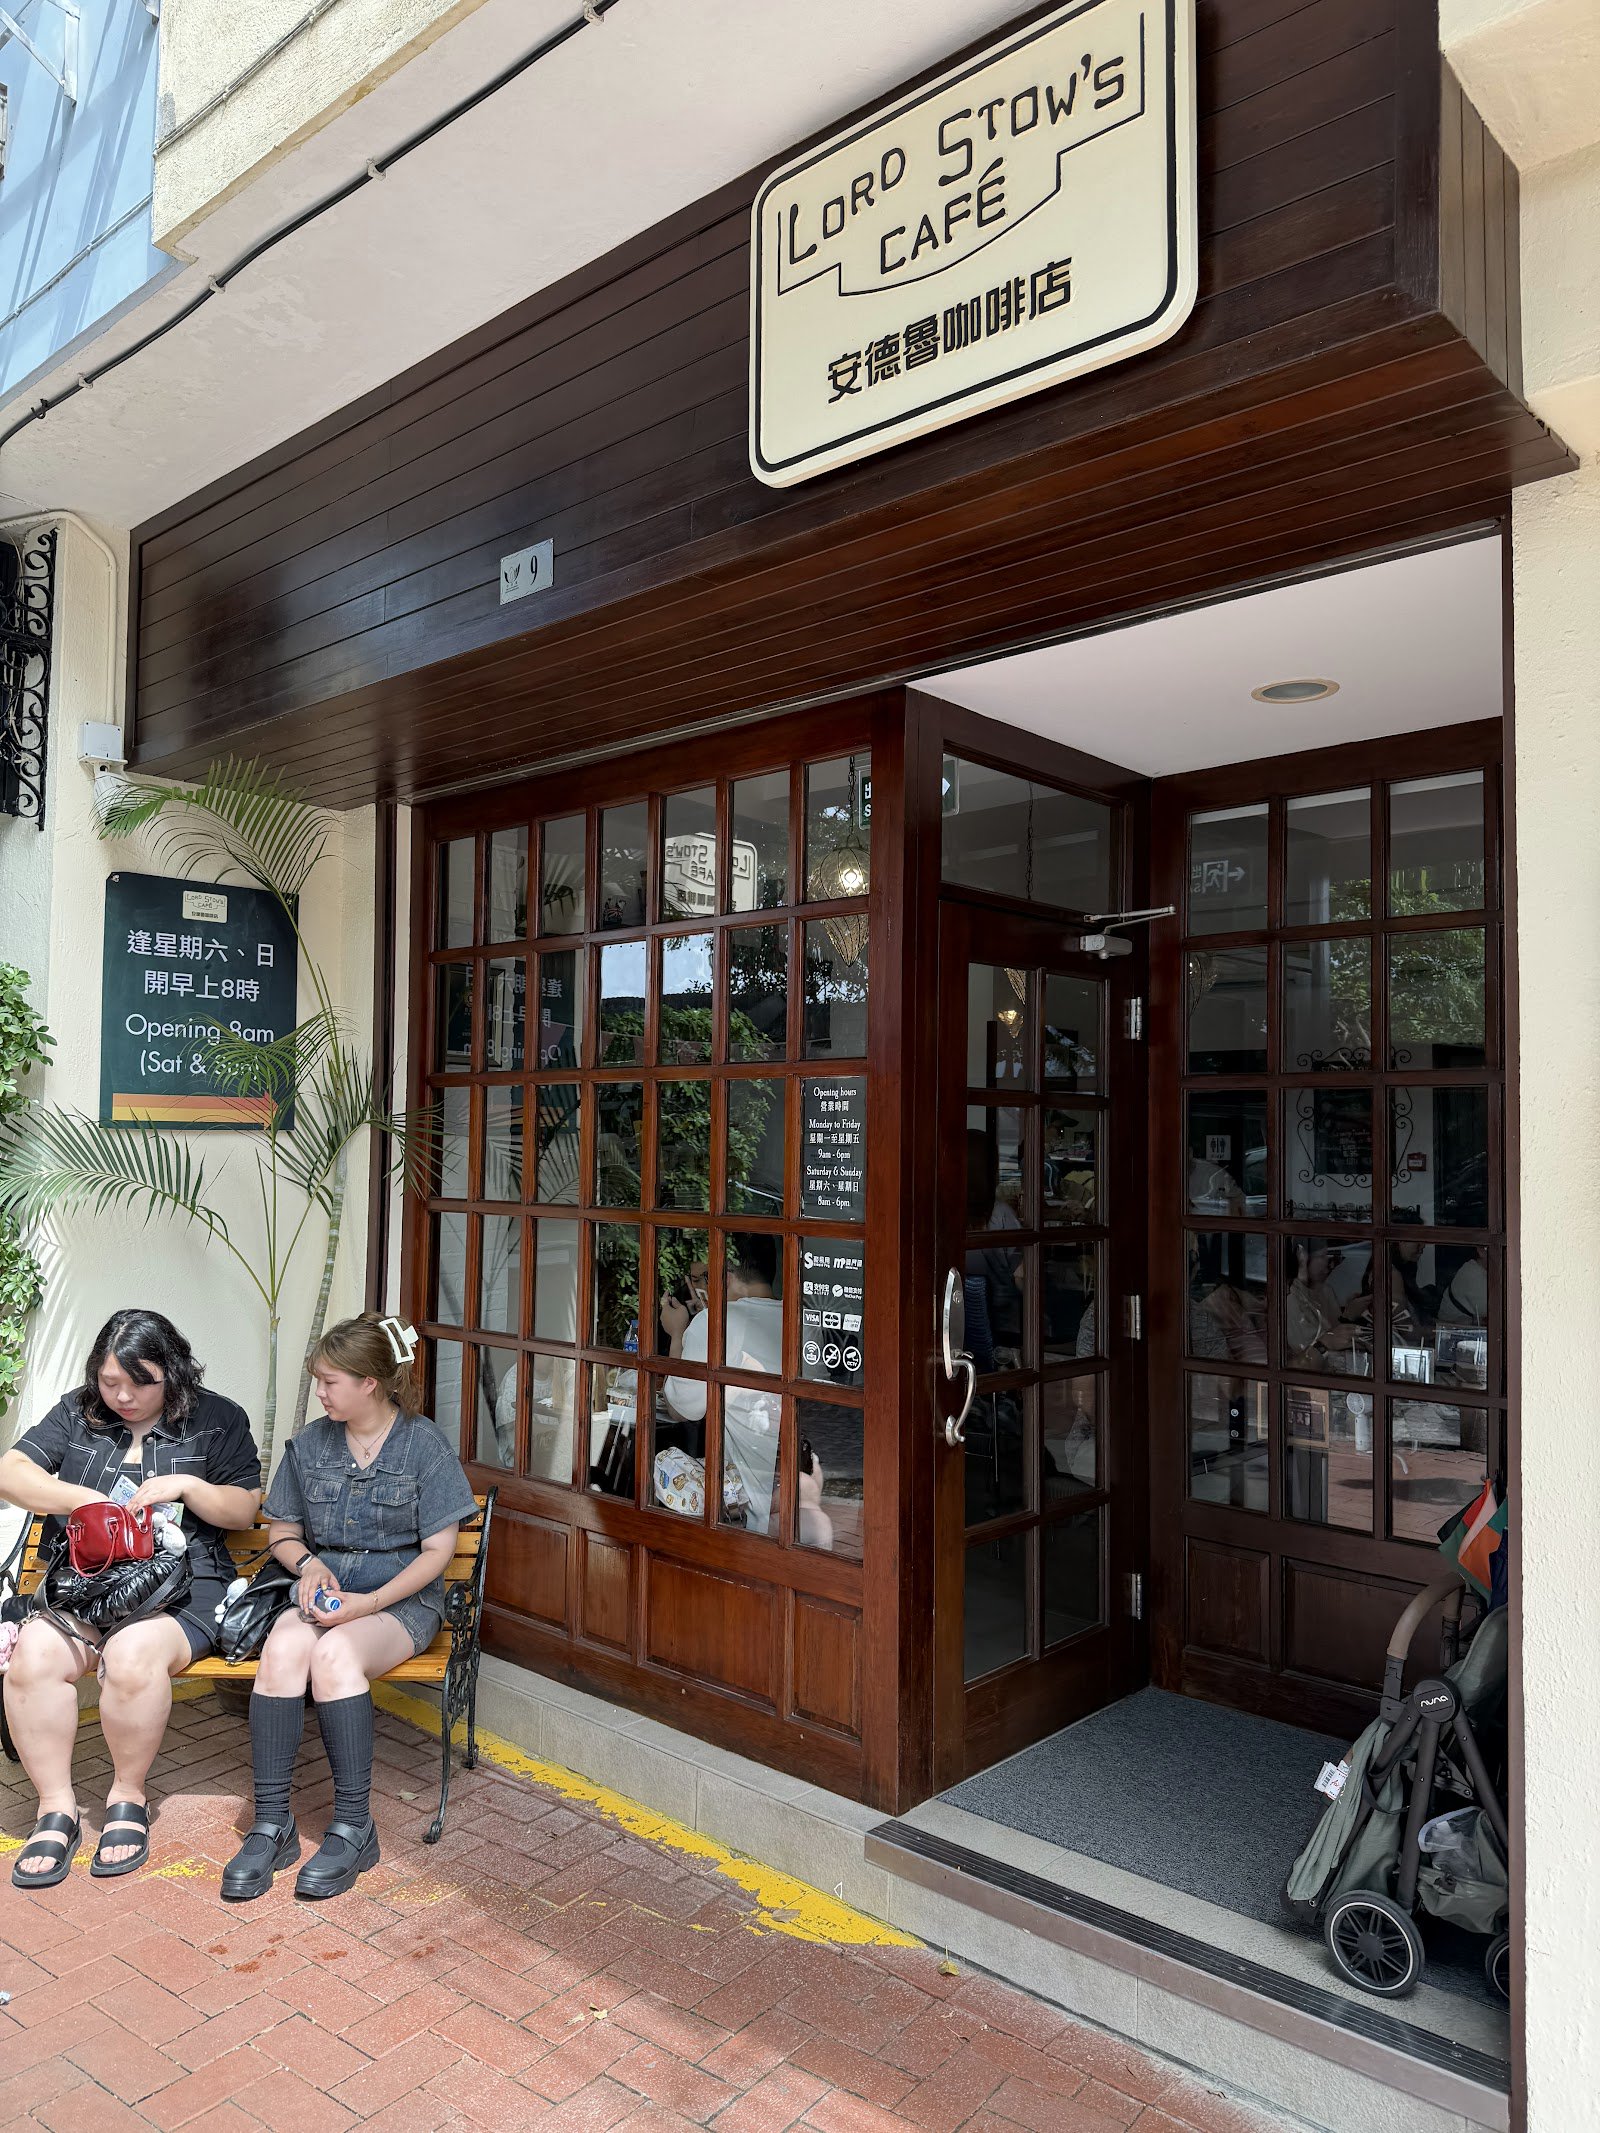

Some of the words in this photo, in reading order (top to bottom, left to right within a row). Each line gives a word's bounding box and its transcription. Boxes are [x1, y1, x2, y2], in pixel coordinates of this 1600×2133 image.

[880, 157, 1006, 275] CAFÉ
[827, 256, 1072, 404] 安德魯咖啡店
[530, 555, 538, 586] 9
[126, 929, 275, 968] 逢星期六、日
[144, 970, 260, 1002] 開早上8時
[125, 1013, 220, 1046] Opening
[229, 1020, 275, 1043] 8am
[140, 1049, 182, 1077] (Sat
[189, 1053, 207, 1075] &
[813, 1086, 839, 1100] Opening
[840, 1086, 857, 1096] hours
[808, 1118, 833, 1132] Monday
[834, 1120, 840, 1129] to
[842, 1118, 861, 1132] Friday
[809, 1132, 860, 1144] 星期一至星期五
[817, 1148, 831, 1159] 9am
[836, 1148, 851, 1162] 6pm
[806, 1165, 832, 1179] Saturday
[833, 1166, 839, 1177] &
[840, 1166, 863, 1180] Sunday
[817, 1195, 831, 1207] 8am
[836, 1196, 850, 1210] 6pm
[805, 1313, 820, 1323] VISA
[1420, 1695, 1449, 1708] nuna
